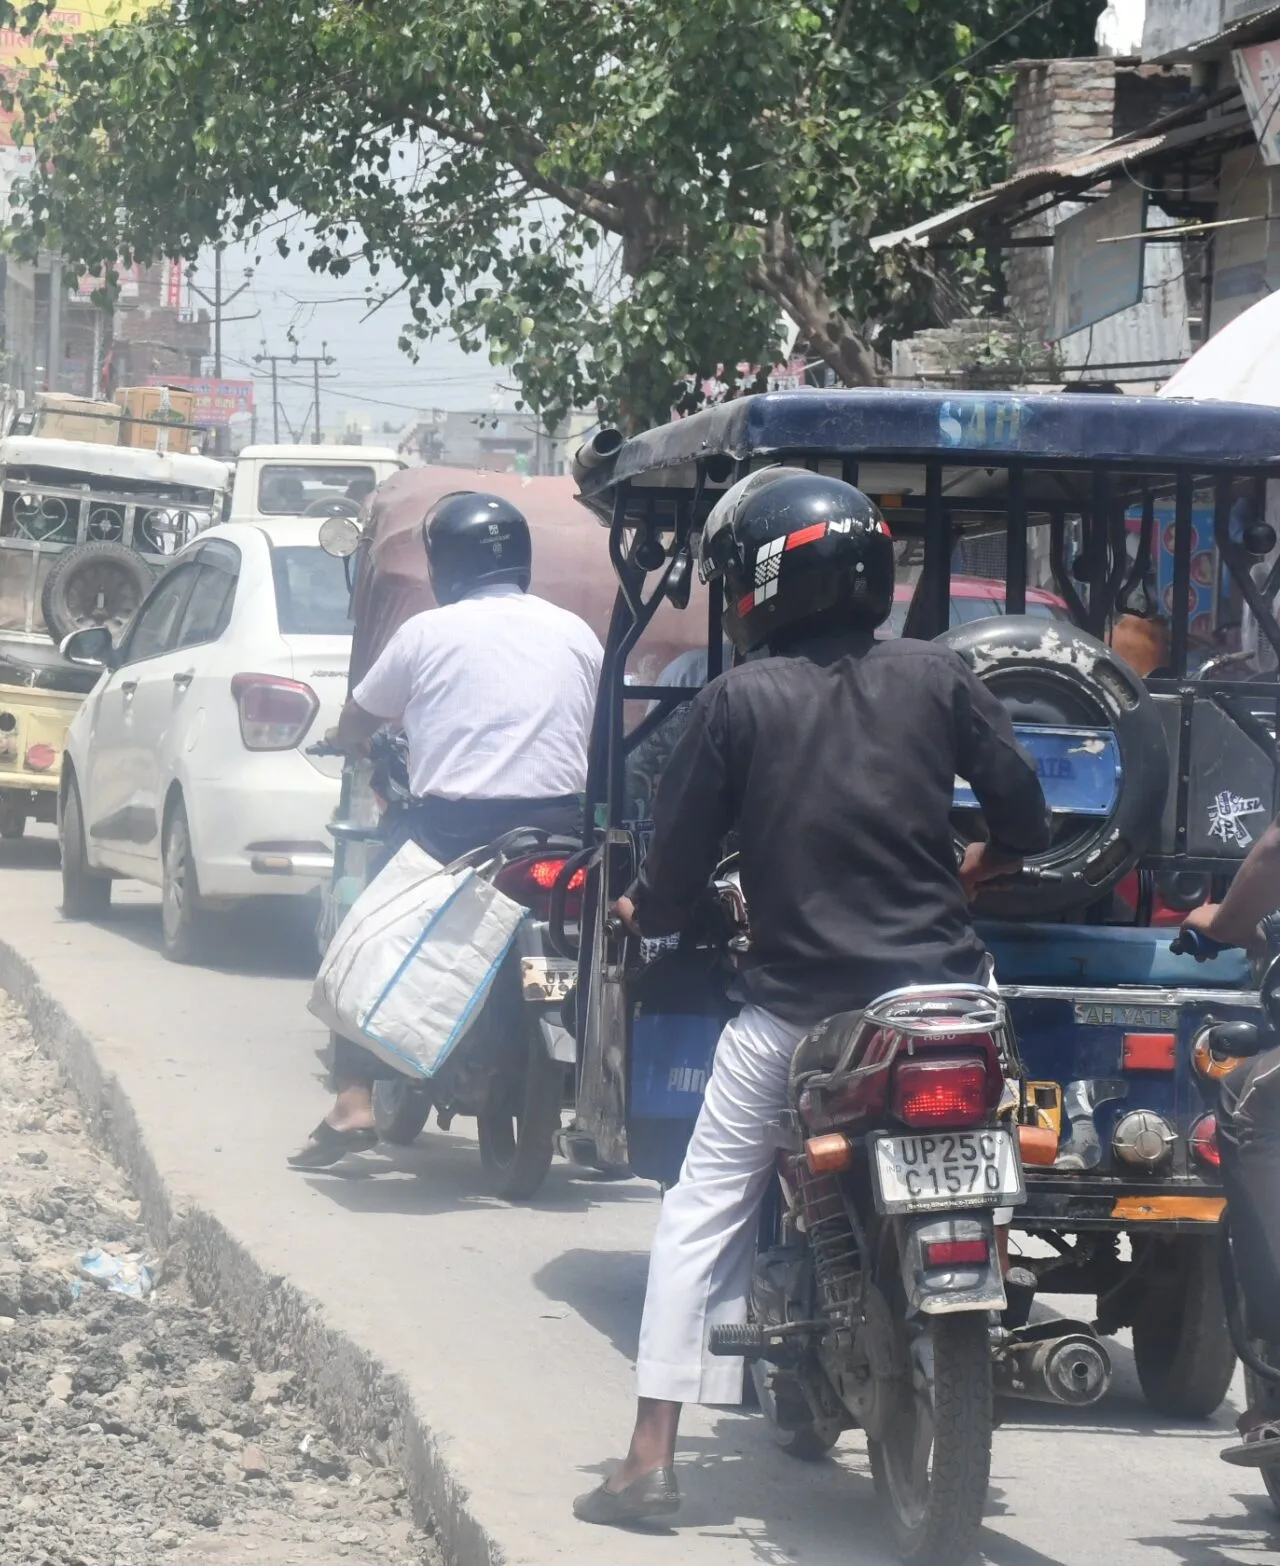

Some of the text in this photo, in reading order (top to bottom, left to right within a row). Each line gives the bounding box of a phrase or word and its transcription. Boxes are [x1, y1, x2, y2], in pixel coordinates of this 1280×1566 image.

[1074, 1003, 1115, 1024] SAH
[901, 1134, 996, 1166] UP25C
[905, 1164, 1001, 1197] C1570
